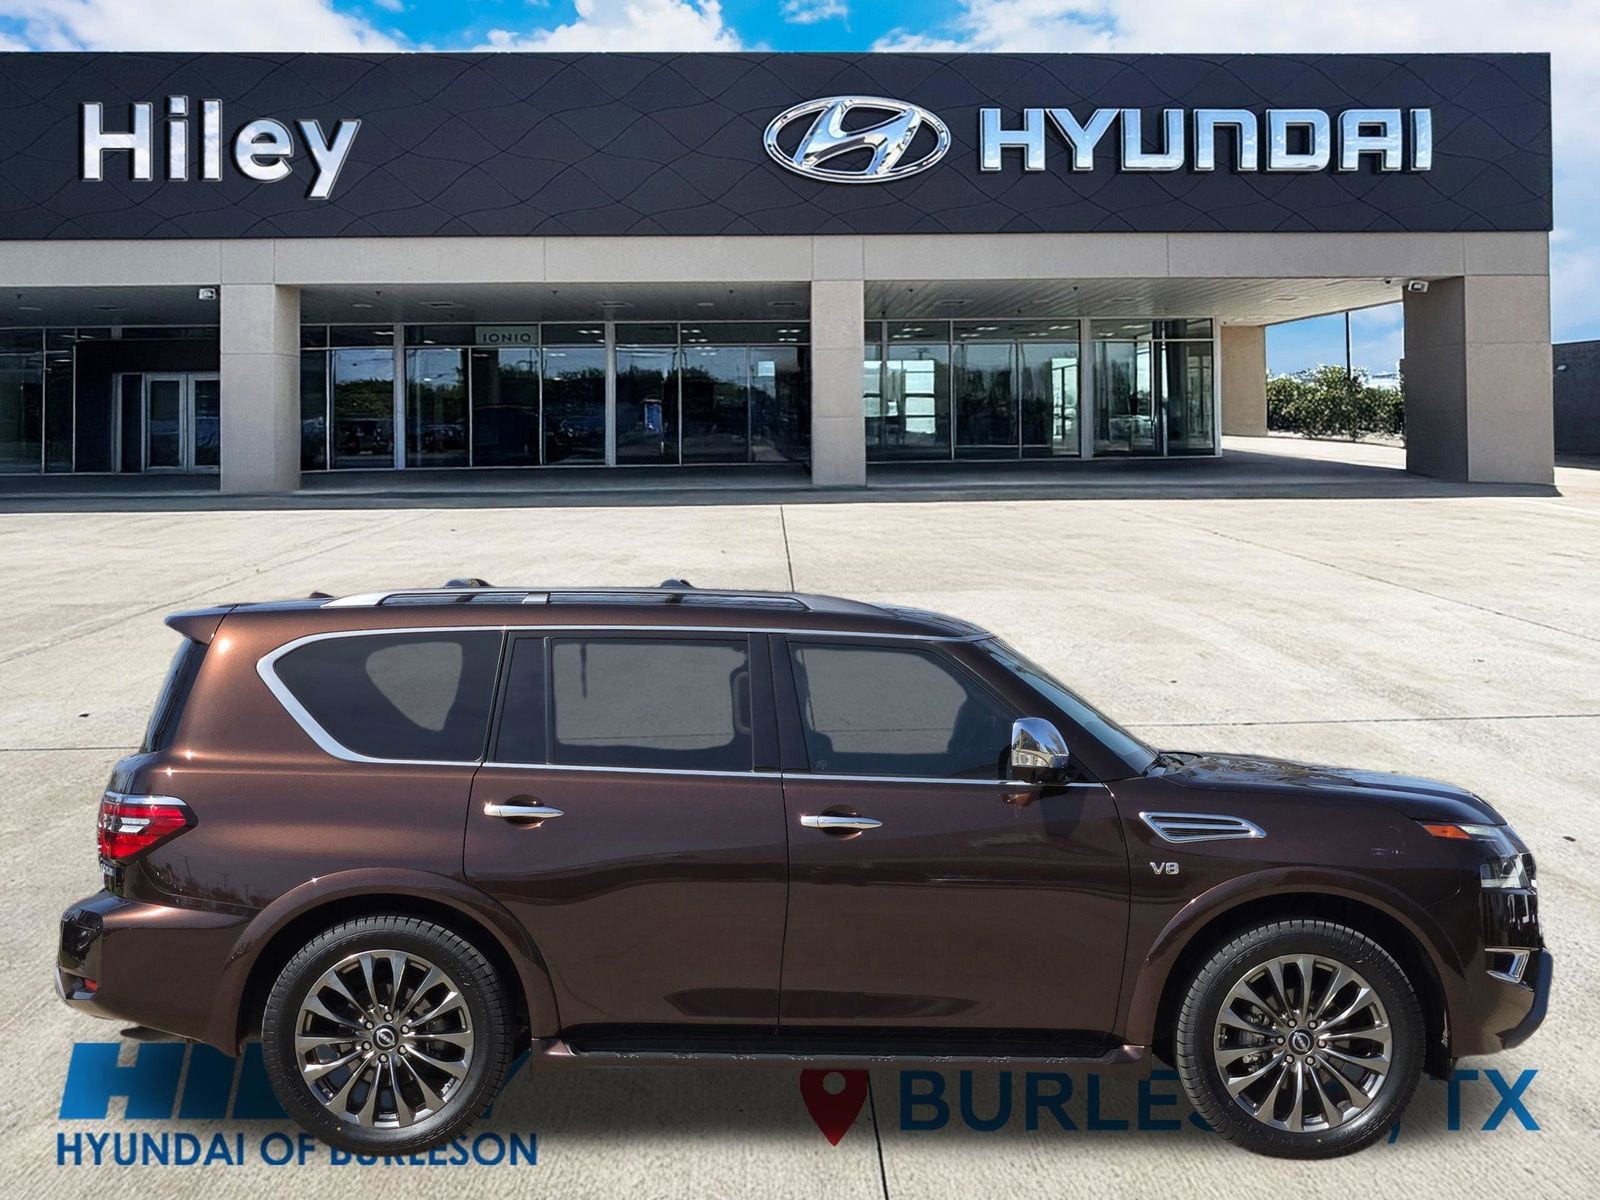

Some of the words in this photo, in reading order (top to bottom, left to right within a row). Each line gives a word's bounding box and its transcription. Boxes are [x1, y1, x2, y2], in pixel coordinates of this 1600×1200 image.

[80, 95, 362, 200] Hiley
[979, 107, 1433, 172] HYUNDAI
[1150, 861, 1180, 875] V8
